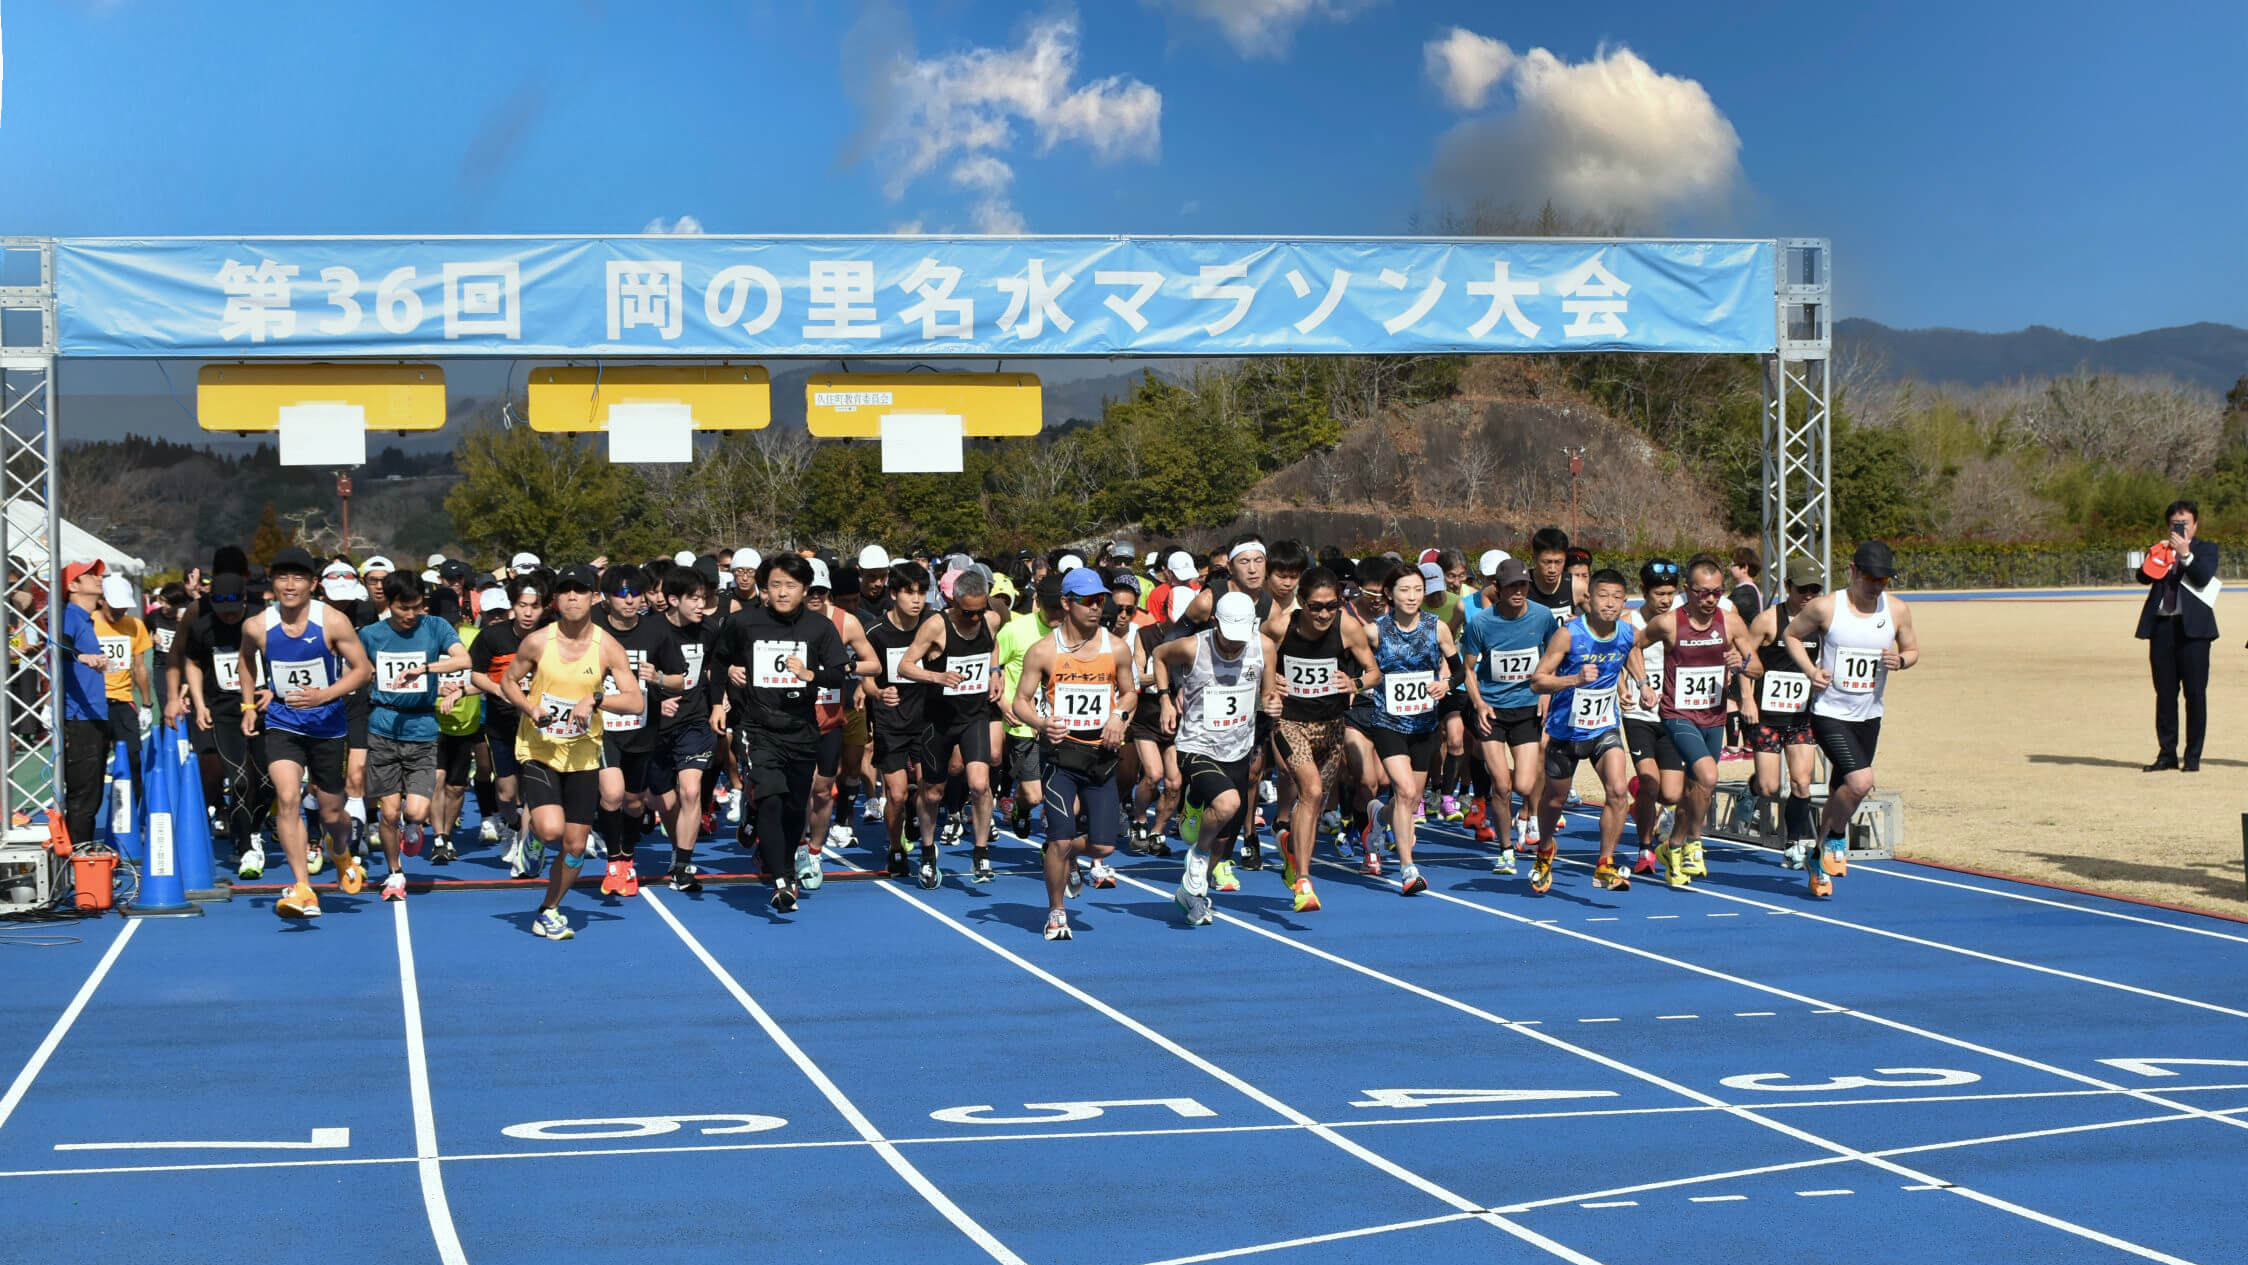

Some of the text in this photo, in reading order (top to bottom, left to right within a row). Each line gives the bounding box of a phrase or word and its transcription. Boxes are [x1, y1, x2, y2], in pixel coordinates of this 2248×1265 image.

[214, 257, 1632, 342] 第36回 岡の里名水マラソン大会
[1500, 657, 1531, 673] 127
[1846, 658, 1878, 679] 101
[288, 669, 312, 686] 43
[1292, 666, 1328, 685] 253
[1394, 681, 1427, 702] 820
[1684, 676, 1716, 696] 341
[1770, 680, 1802, 699] 219
[1065, 695, 1101, 715] 124
[1226, 696, 1237, 716] 3
[1580, 696, 1611, 716] 317
[1718, 1067, 1983, 1091] 3
[1347, 1088, 1620, 1108] 4
[928, 1097, 1218, 1124] 5
[500, 1113, 788, 1140] 6
[54, 1127, 350, 1150] 7
